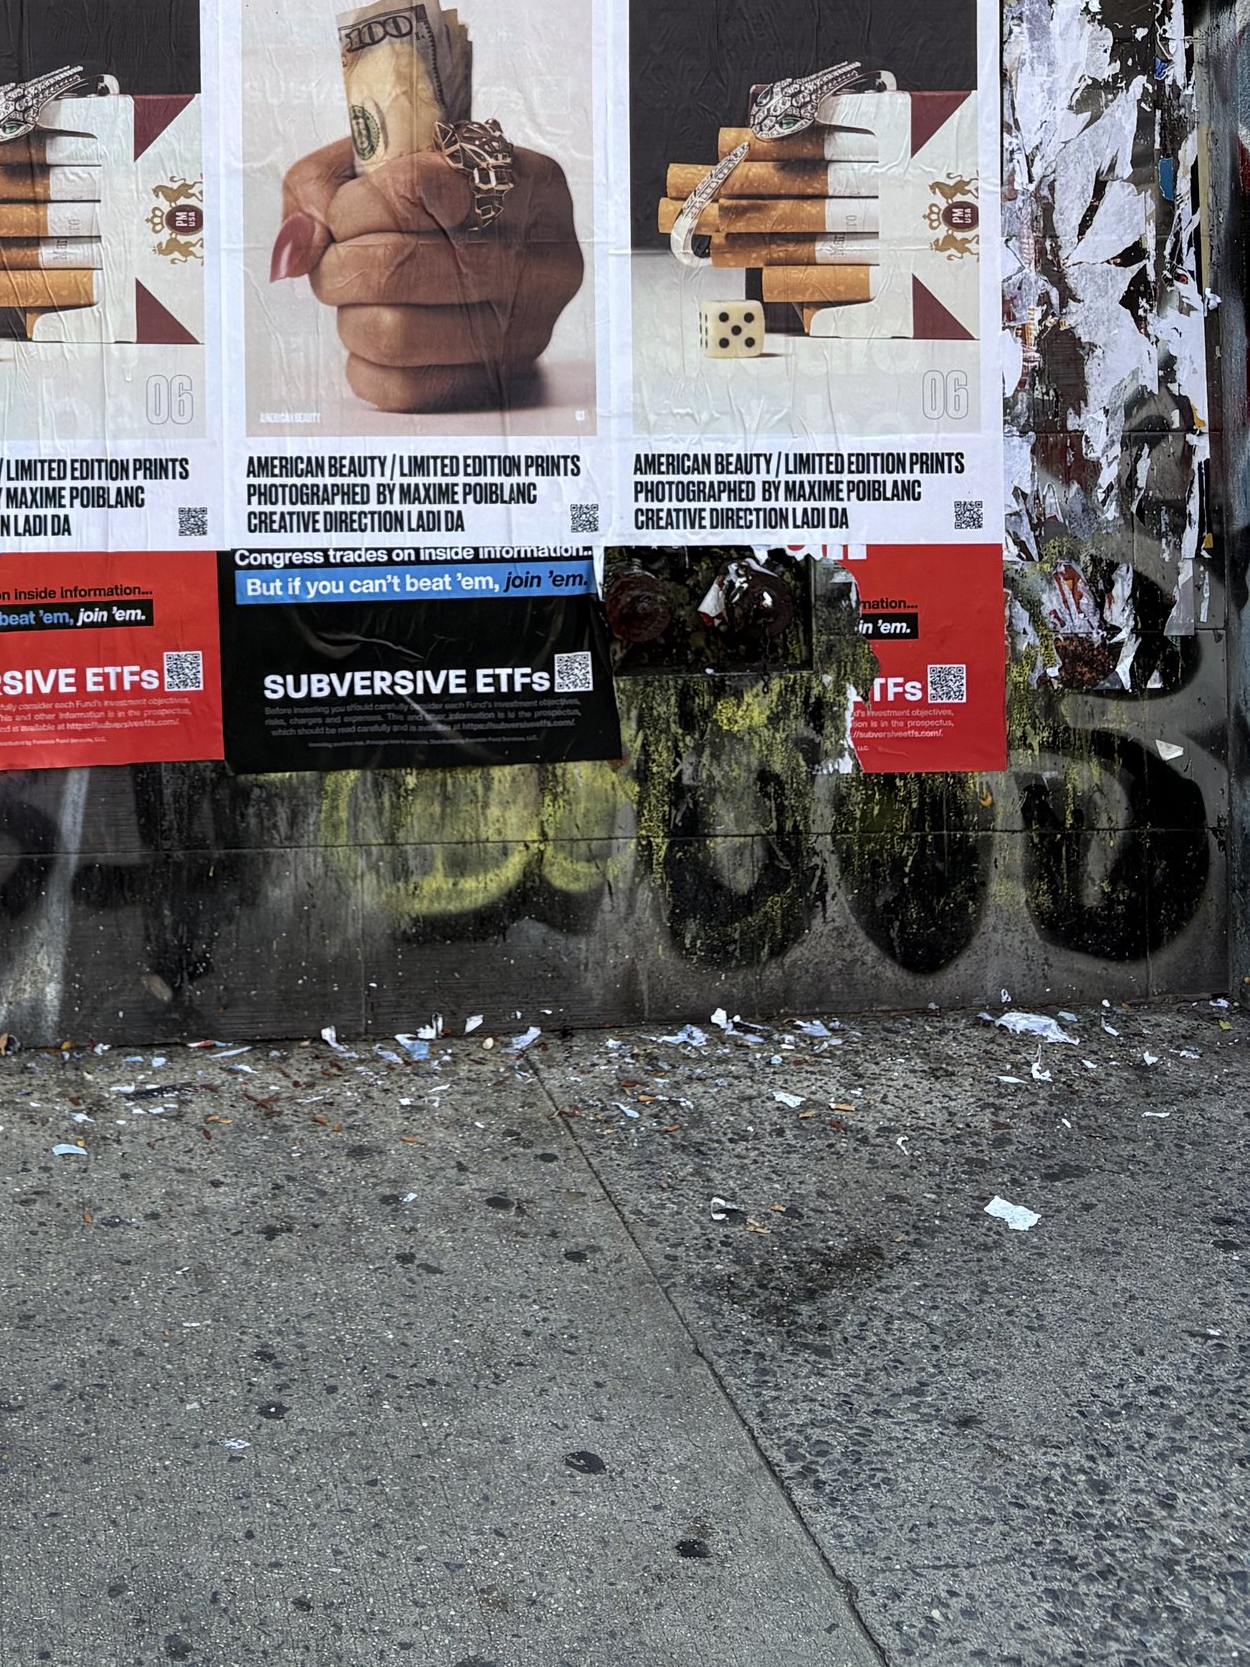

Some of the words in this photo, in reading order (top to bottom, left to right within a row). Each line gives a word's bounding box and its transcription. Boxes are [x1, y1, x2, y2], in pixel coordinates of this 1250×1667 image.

[345, 15, 415, 53] 100
[952, 208, 964, 224] PM
[146, 374, 194, 425] 06
[921, 369, 969, 420] 06
[6, 458, 66, 480] LIMITED
[70, 458, 129, 480] EDITION
[132, 457, 188, 479] PRINTS
[246, 455, 324, 477] AMERICAN
[328, 455, 386, 477] BEAUTY
[399, 455, 459, 476] LIMITED
[463, 455, 521, 476] EDITION
[524, 454, 580, 476] PRINTS
[6, 486, 65, 508] MAXIME
[69, 486, 144, 508] POIBLANC
[247, 483, 369, 505] PHOTOGRAPHED
[376, 482, 395, 504] BY
[399, 482, 458, 504] MAXIME
[462, 482, 536, 504] POIBLANC
[14, 514, 47, 536] LADI
[51, 514, 71, 536] DA
[247, 511, 319, 533] CREATIVE
[323, 510, 403, 532] DIRECTION
[407, 510, 441, 531] LADI
[444, 510, 464, 531] DA
[235, 550, 323, 568] Congress
[328, 548, 387, 564] trades
[392, 550, 415, 562] on
[14, 588, 56, 601] inside
[246, 580, 282, 596] But
[287, 579, 302, 596] if
[306, 582, 345, 599] you
[349, 576, 402, 594] can't
[405, 574, 452, 592] beat
[503, 571, 542, 593] join
[76, 608, 108, 626] join
[85, 665, 159, 692] ETFs
[263, 670, 466, 699] SUBVERSIVE
[476, 667, 550, 694] ETFs
[856, 677, 922, 701] TFs
